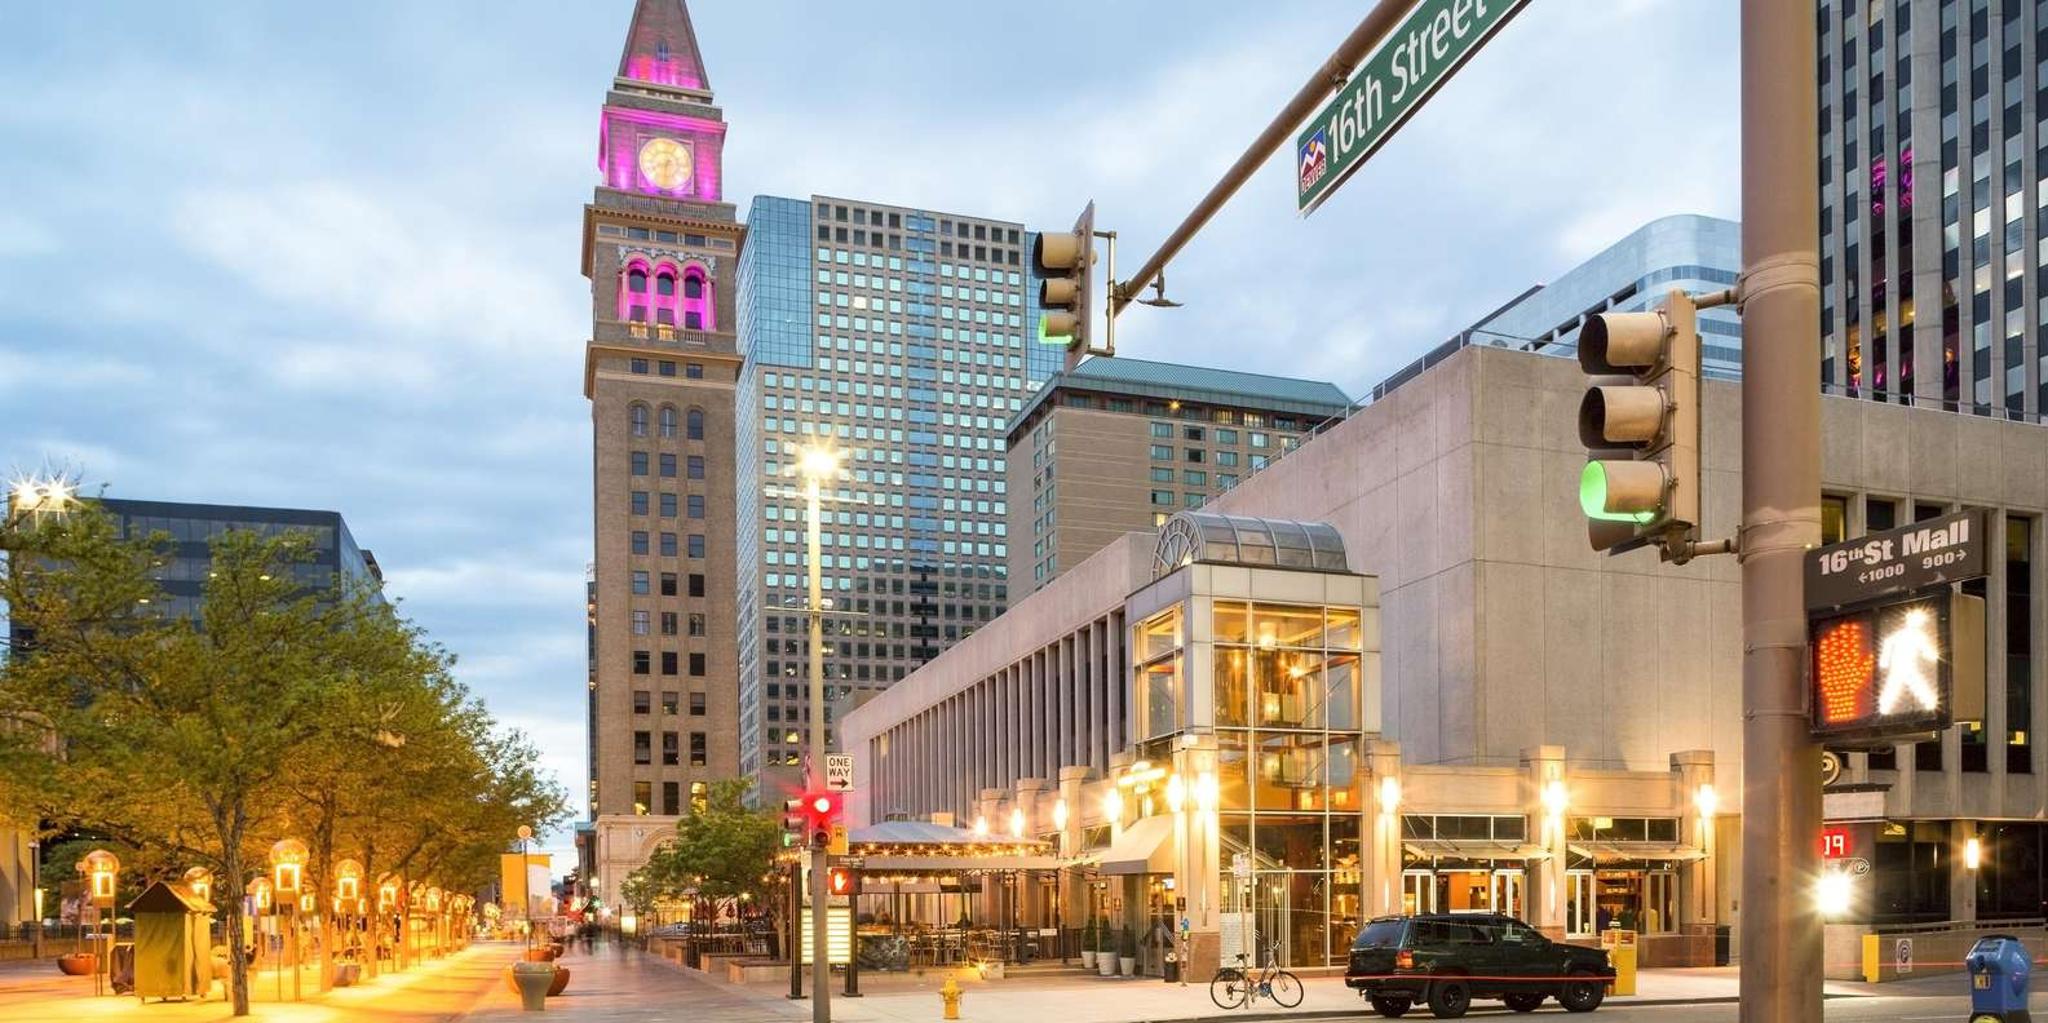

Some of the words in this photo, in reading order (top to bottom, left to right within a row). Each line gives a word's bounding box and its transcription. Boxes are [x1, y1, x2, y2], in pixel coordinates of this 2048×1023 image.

[1328, 74, 1383, 163] 16th
[1902, 519, 1969, 556] Mall
[1869, 563, 1905, 582] 1000
[1922, 552, 1954, 569] 900
[829, 757, 850, 767] ONE
[829, 768, 850, 776] WAY
